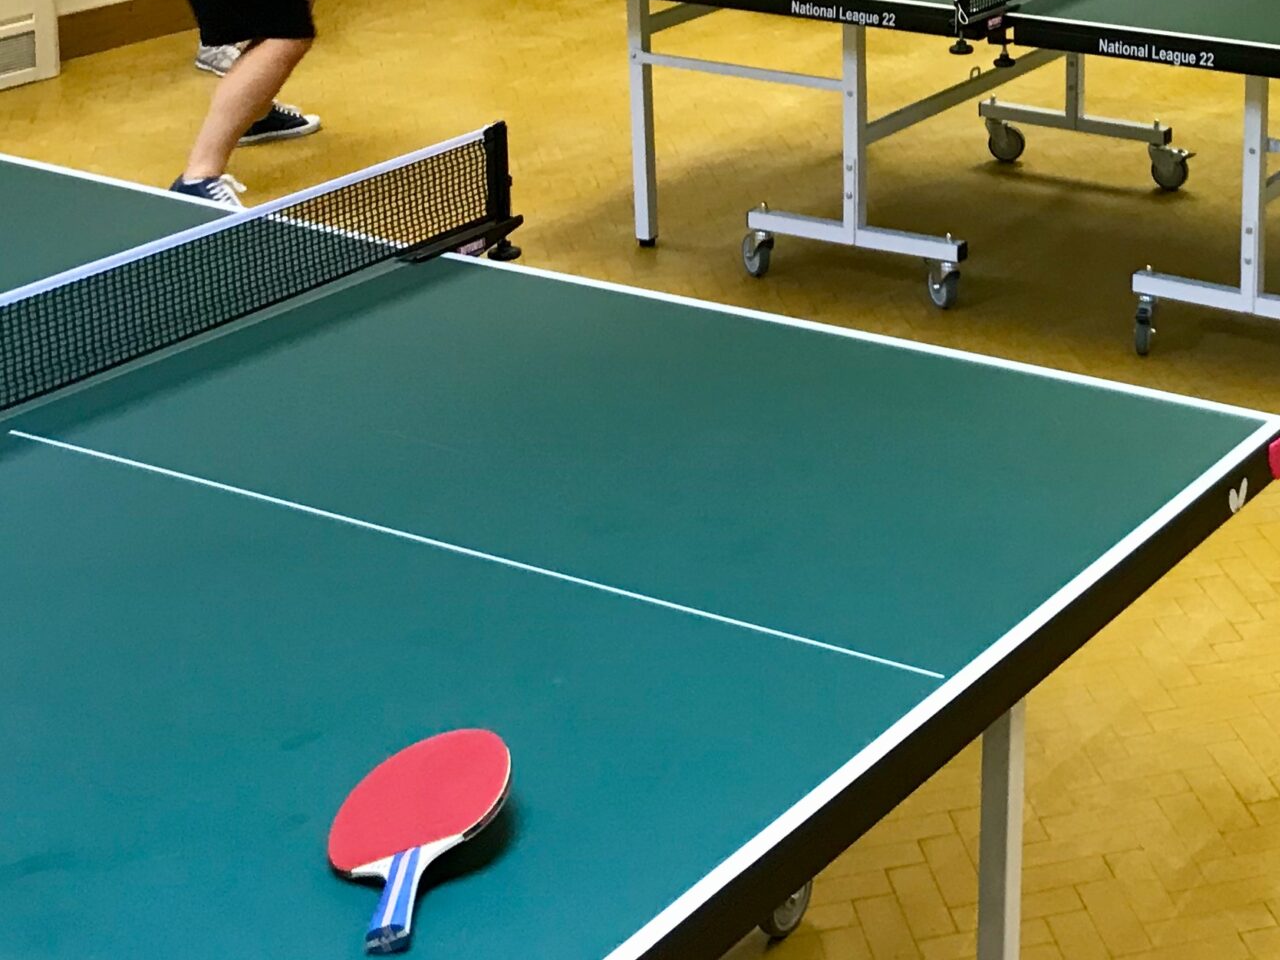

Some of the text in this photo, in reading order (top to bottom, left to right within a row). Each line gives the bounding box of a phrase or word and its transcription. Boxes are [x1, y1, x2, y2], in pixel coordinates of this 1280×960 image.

[791, 0, 896, 27] National League 22
[1099, 38, 1215, 67] National League 22
